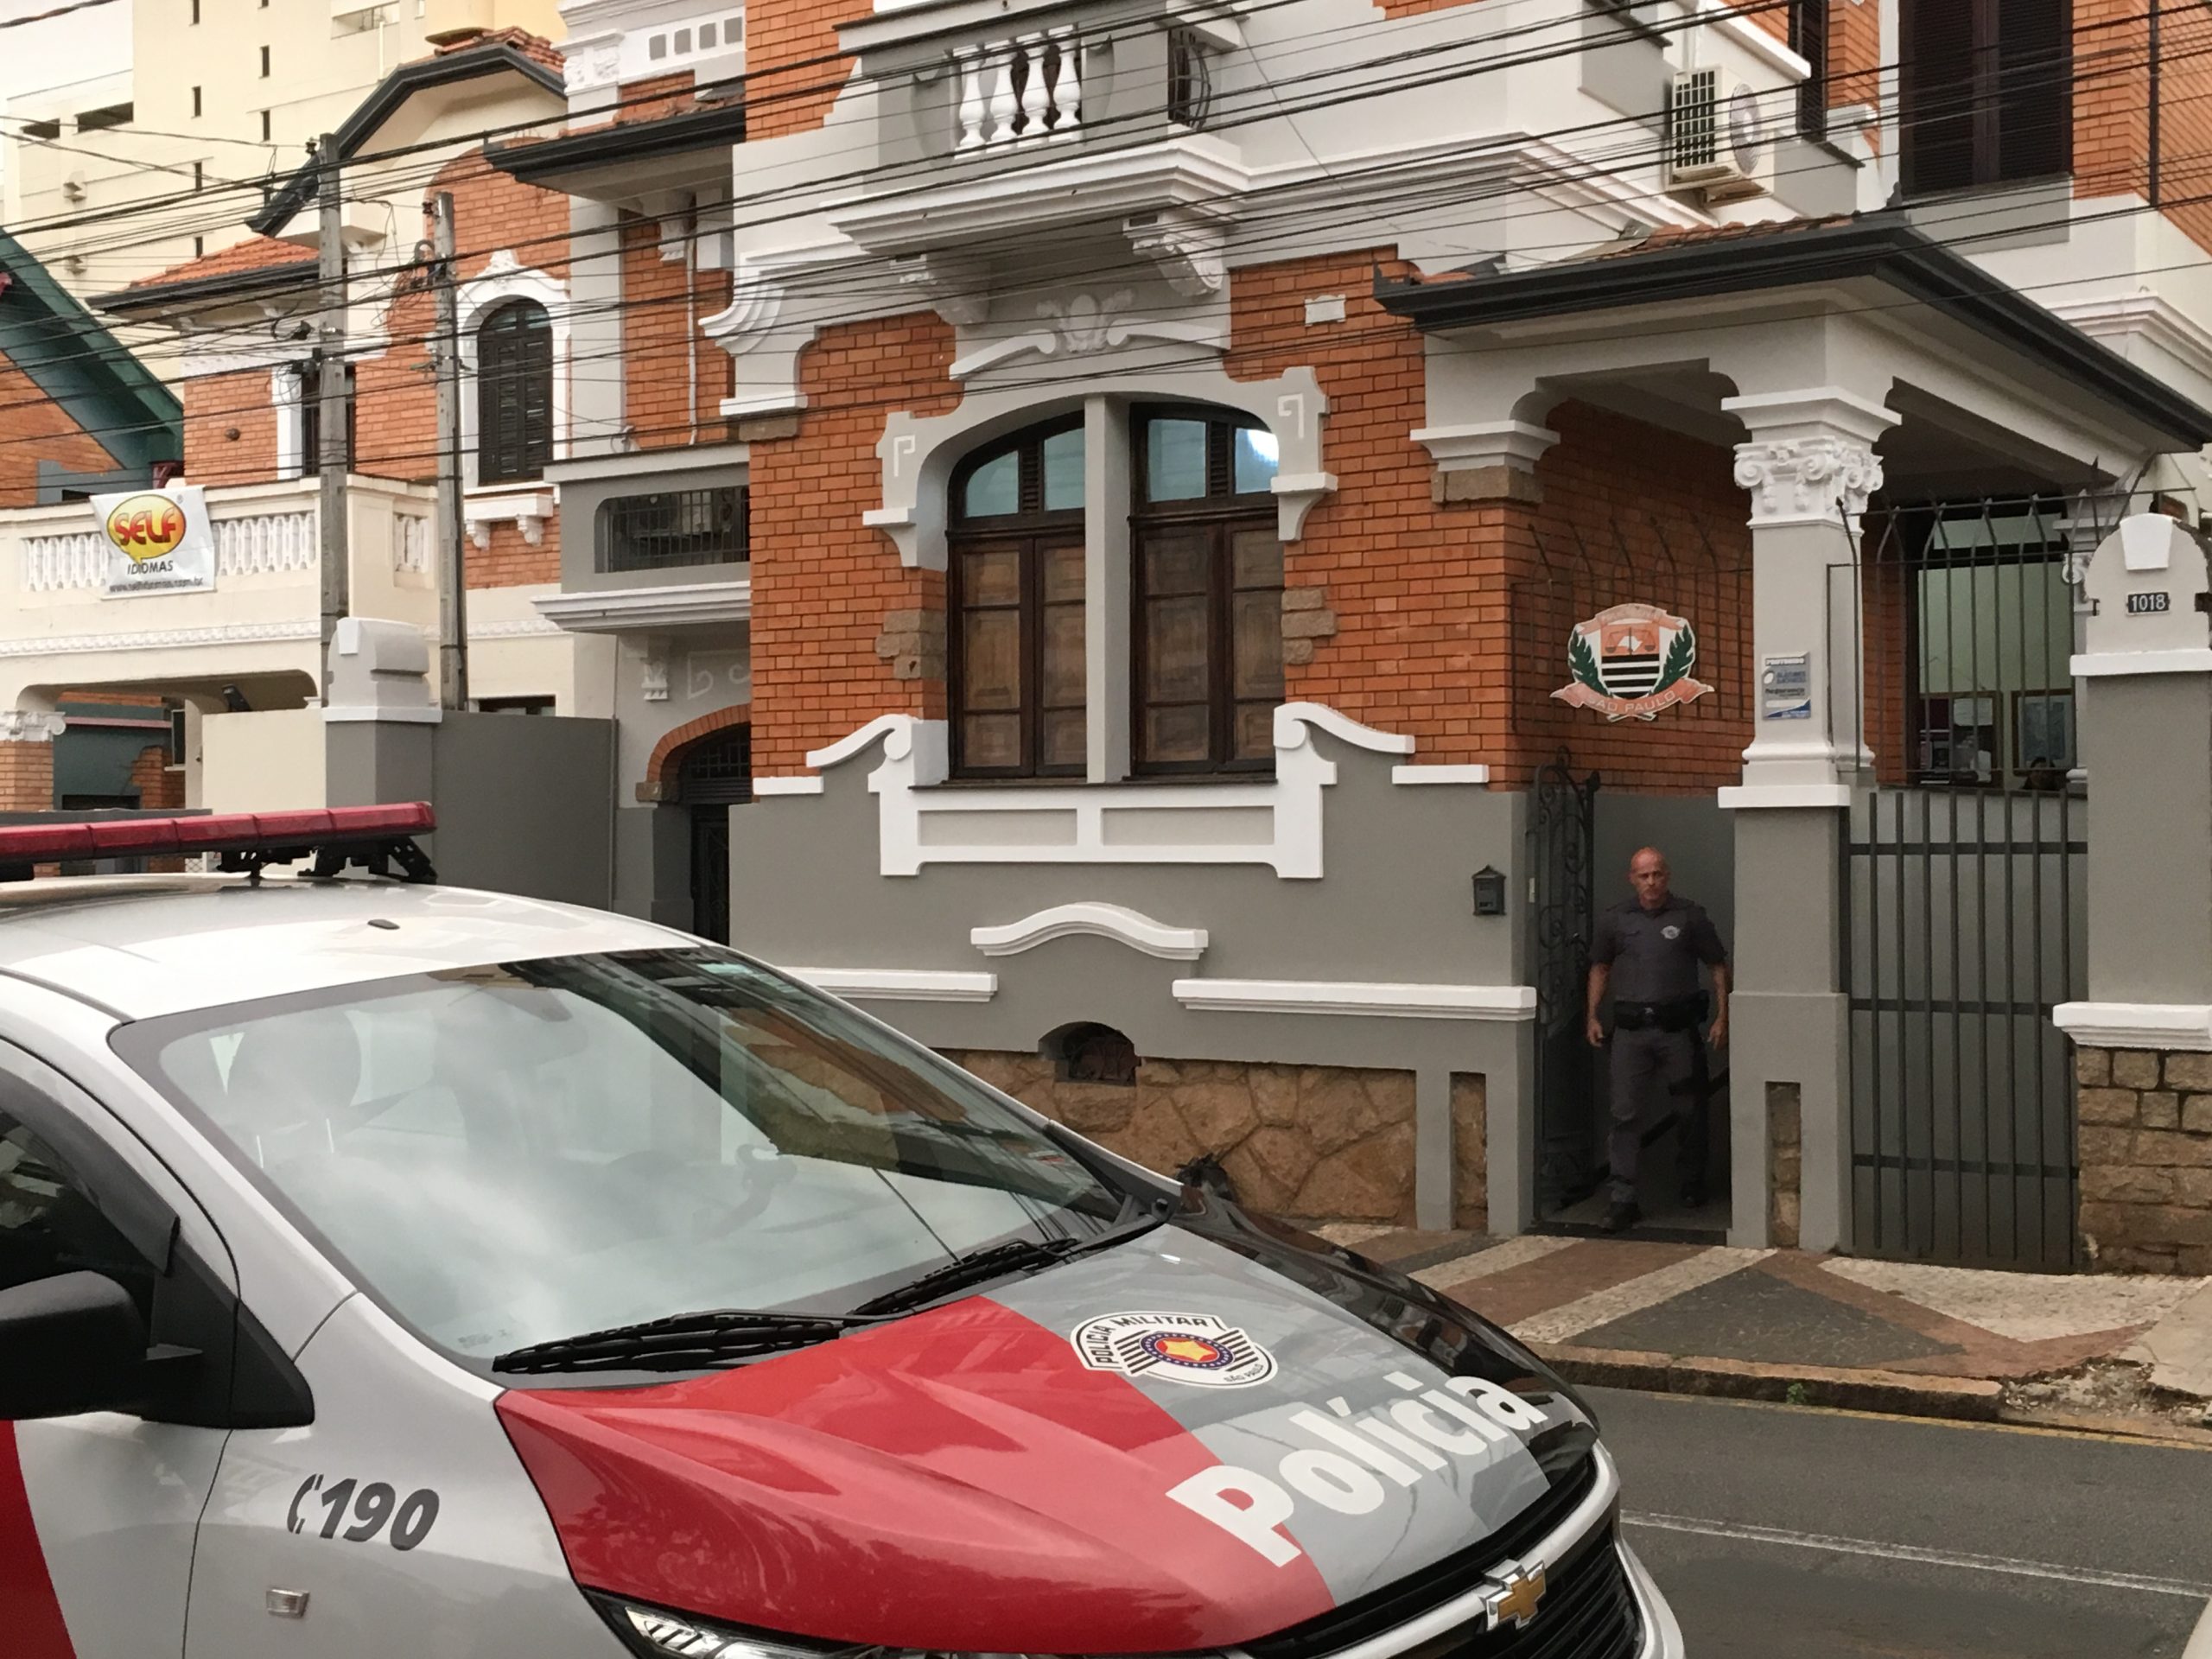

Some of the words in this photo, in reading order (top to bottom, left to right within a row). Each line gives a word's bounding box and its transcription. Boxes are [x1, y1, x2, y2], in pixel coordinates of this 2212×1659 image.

[114, 507, 176, 545] SELF
[127, 560, 174, 575] IDIOMAS
[2131, 594, 2166, 612] 1018
[1625, 690, 1676, 712] PAULO
[1109, 1316, 1209, 1327] MILITAR
[1165, 1376, 1548, 1567] Polícia
[320, 1478, 440, 1551] 190
